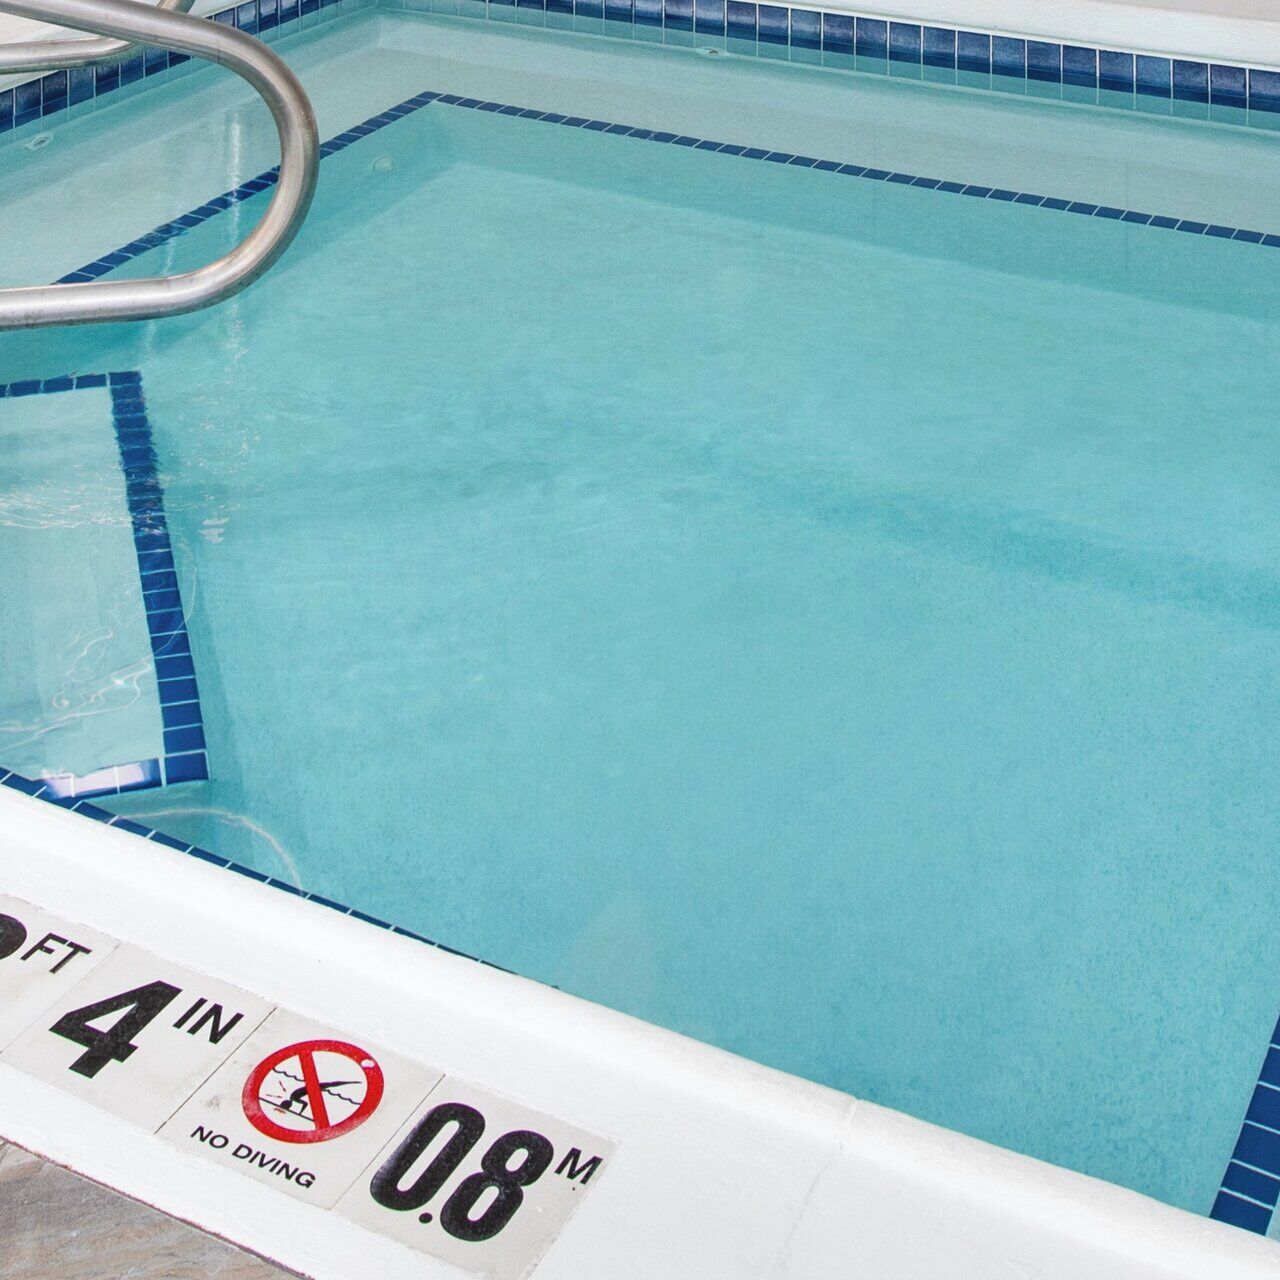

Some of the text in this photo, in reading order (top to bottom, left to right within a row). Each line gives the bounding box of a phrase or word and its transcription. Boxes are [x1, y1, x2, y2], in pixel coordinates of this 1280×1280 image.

[20, 932, 93, 975] FT
[48, 980, 184, 1080] 4
[172, 996, 245, 1046] IN
[190, 1125, 317, 1190] NO DIVING
[370, 1102, 604, 1243] 0.8 M
